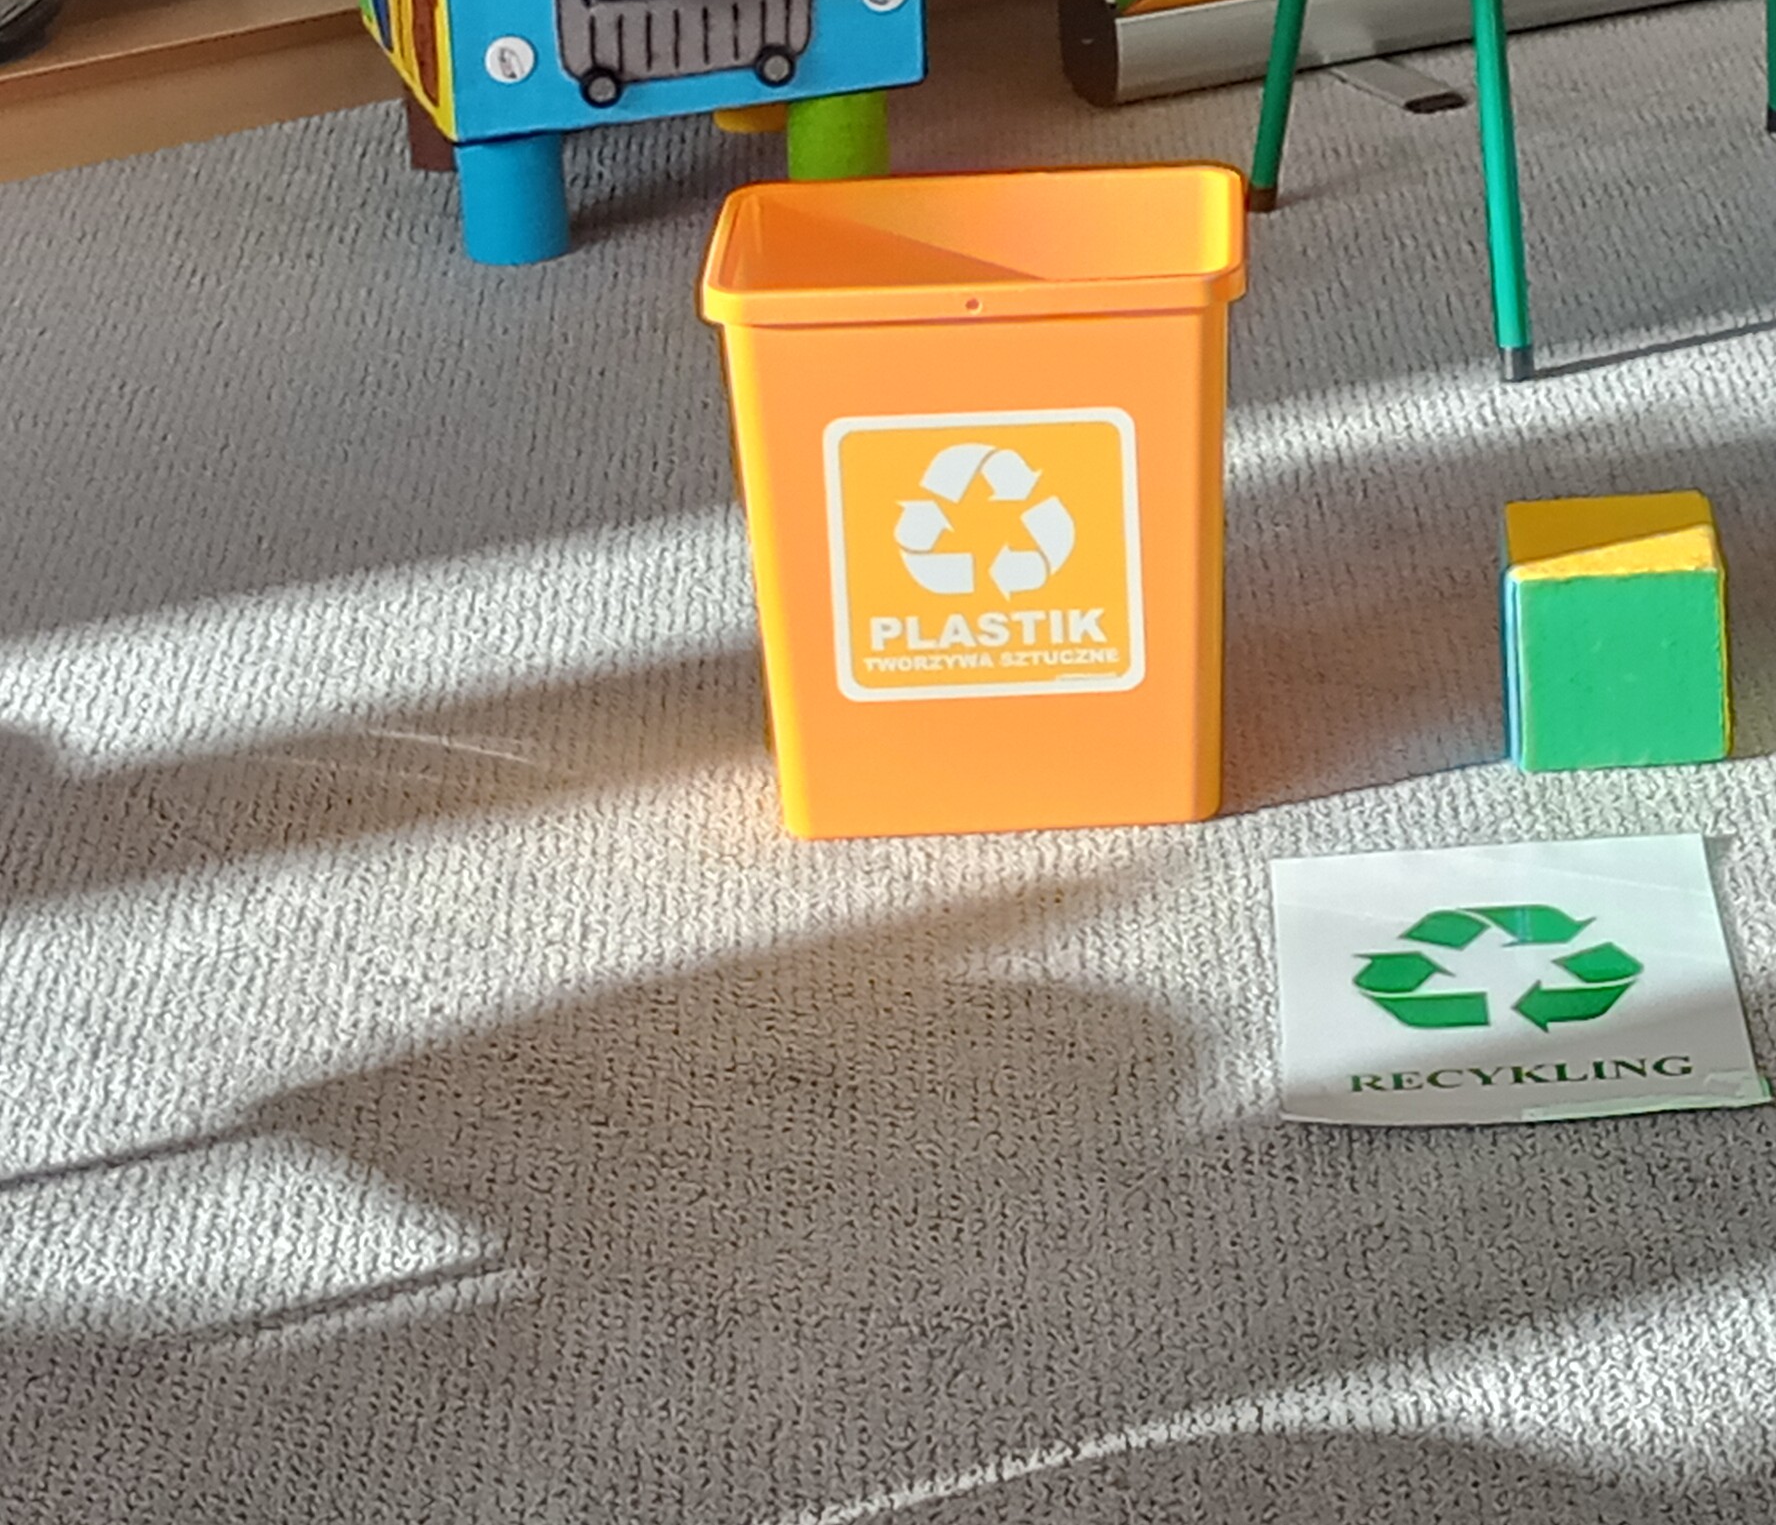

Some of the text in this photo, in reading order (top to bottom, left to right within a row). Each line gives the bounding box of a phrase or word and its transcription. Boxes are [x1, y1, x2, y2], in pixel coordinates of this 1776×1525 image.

[868, 607, 1108, 653] PLASTIK
[863, 647, 1121, 673] TWORZYWA SZTUCZNE
[1348, 1054, 1696, 1094] RECYKLING
